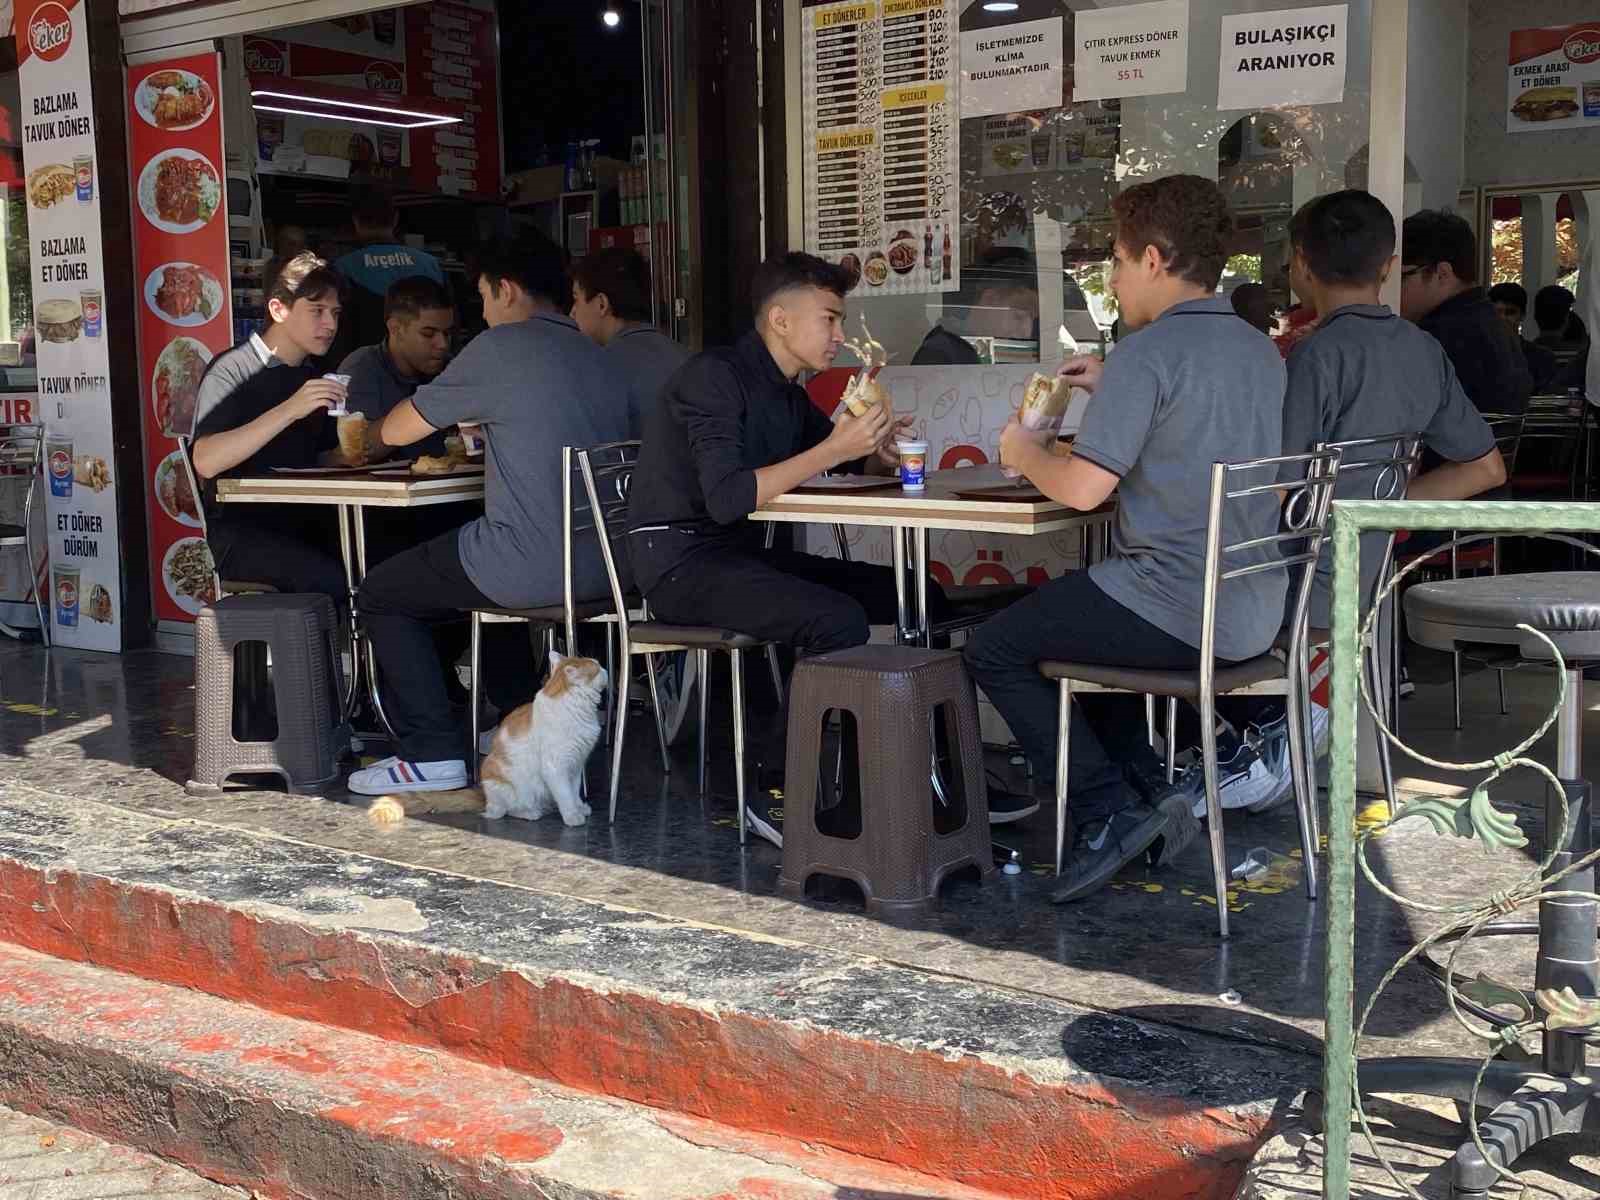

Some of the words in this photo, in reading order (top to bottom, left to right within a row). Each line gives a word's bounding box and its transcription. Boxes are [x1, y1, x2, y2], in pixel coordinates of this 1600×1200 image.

[976, 33, 1044, 52] İŞLETMEMİZDE
[1084, 37, 1106, 50] ÇITIR
[1108, 34, 1144, 47] EXPRESS
[1146, 29, 1178, 42] DÖNER
[1234, 24, 1335, 45] BULAŞIKÇI
[995, 51, 1025, 63] KLİMA
[1100, 52, 1128, 64] TAVUK
[1130, 49, 1161, 61] EKMEK
[1237, 52, 1335, 72] ARANIYOR
[970, 63, 1050, 81] BULUNMAKTADIR
[1118, 69, 1130, 81] 55
[1132, 68, 1144, 79] TL
[1514, 64, 1542, 76] EKMEK
[1545, 62, 1570, 73] ARASI
[1521, 78, 1531, 88] ET
[1534, 75, 1561, 87] DÖNER
[33, 92, 78, 116] BAZLAMA
[25, 122, 56, 142] TAVUK
[58, 115, 91, 138] DÖNER
[41, 237, 86, 257] BAZLAMA
[363, 252, 416, 268] Arçelik
[42, 265, 53, 282] ET
[56, 260, 88, 281] DÖNER
[40, 376, 72, 394] TAVUK
[57, 513, 68, 531] ET
[71, 510, 102, 533] DÖNER
[63, 535, 98, 557] DÜRÜM
